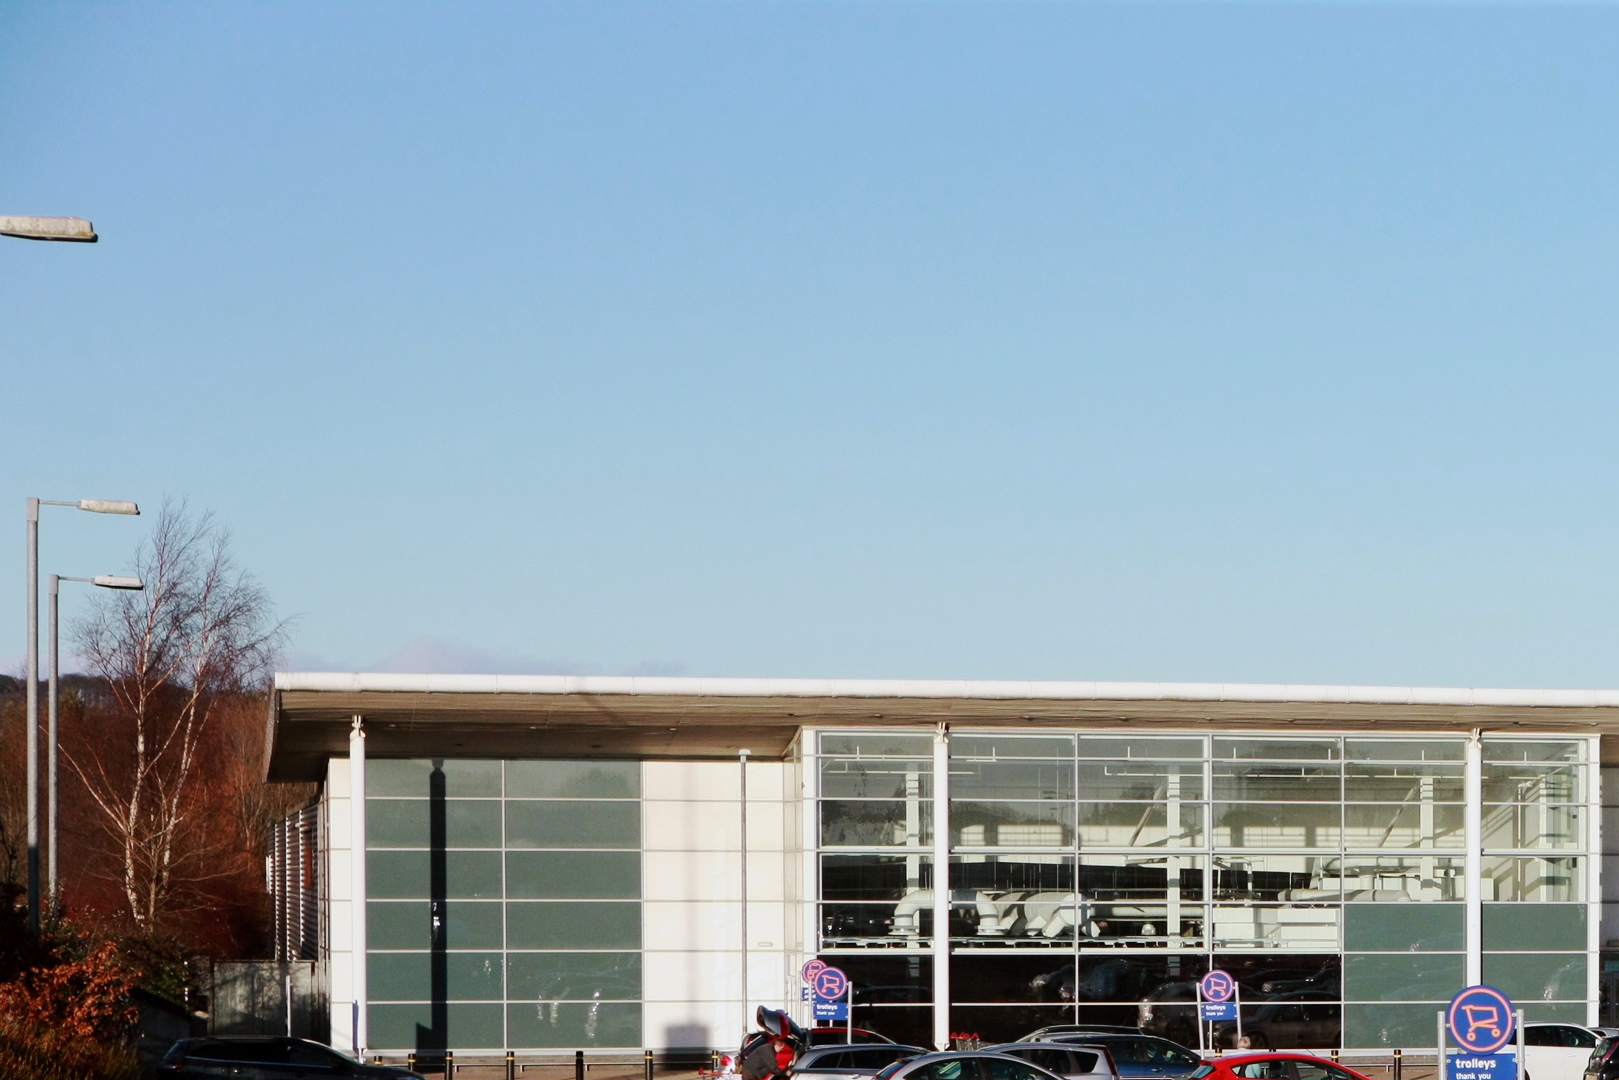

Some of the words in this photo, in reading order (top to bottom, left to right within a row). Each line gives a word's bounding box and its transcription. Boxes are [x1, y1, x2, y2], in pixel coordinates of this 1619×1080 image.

[1456, 1058, 1496, 1070] trolleys
[1456, 1072, 1476, 1080] thank
[1478, 1073, 1491, 1080] you
